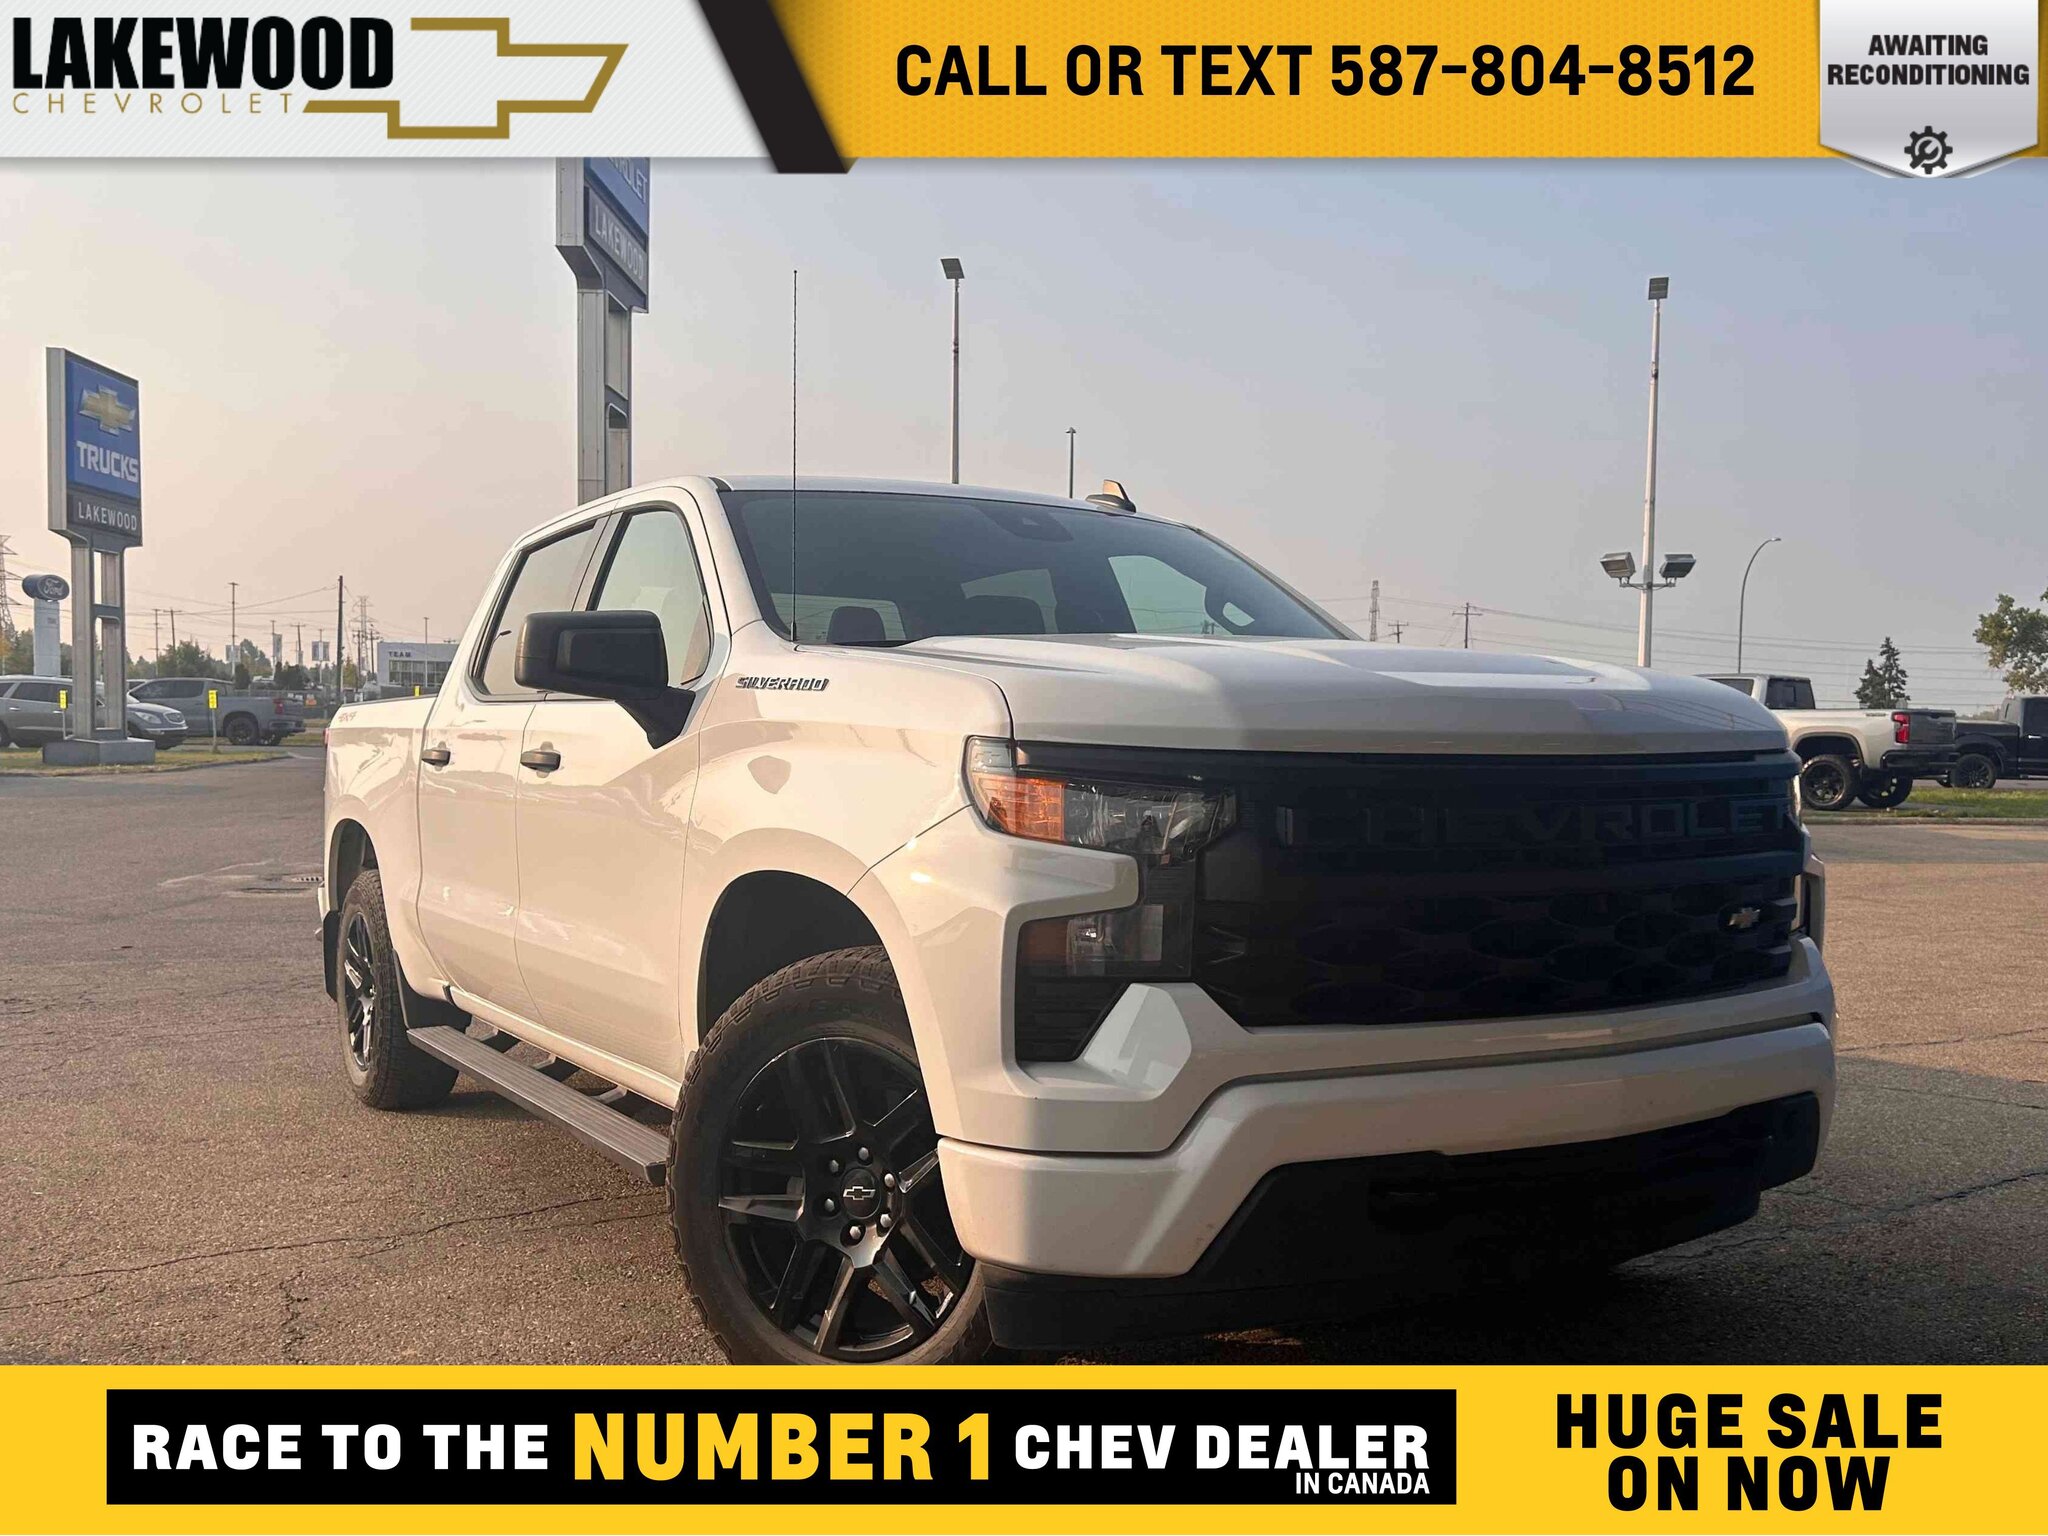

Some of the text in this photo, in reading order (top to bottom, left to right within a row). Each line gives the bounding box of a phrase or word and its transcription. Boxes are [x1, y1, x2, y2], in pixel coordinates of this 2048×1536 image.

[595, 205, 644, 280] LAKEWOOD
[76, 440, 139, 483] TRUCKS
[78, 501, 138, 531] LAKEWOOD
[735, 676, 830, 692] SILVERADO
